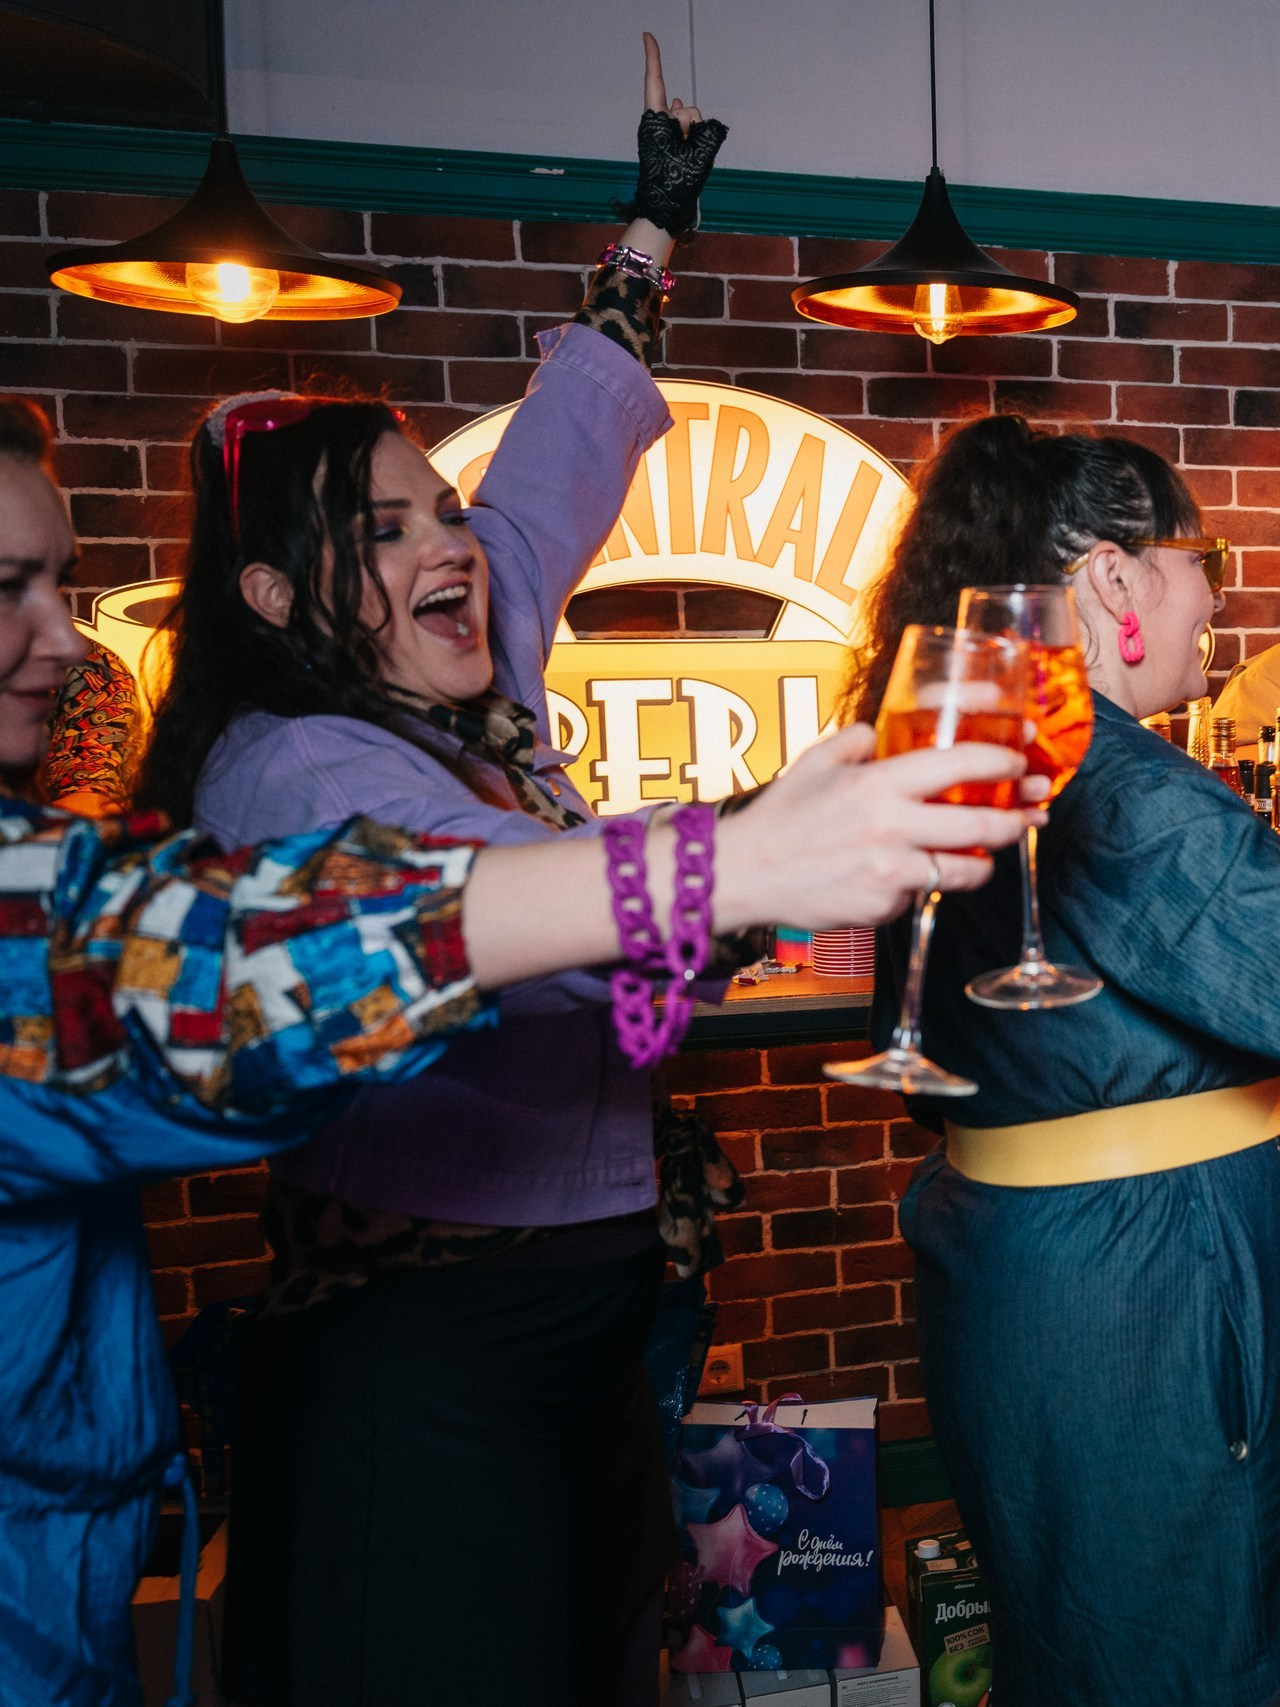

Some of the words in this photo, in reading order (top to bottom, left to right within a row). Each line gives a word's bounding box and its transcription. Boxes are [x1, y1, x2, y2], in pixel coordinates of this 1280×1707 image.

[457, 402, 883, 606] NTRAL
[798, 1528, 810, 1550] С
[811, 1534, 844, 1556] днём
[935, 1599, 992, 1624] Добры
[946, 1632, 967, 1645] 100%
[967, 1626, 985, 1637] СОК
[949, 1643, 965, 1654] БЕЗ
